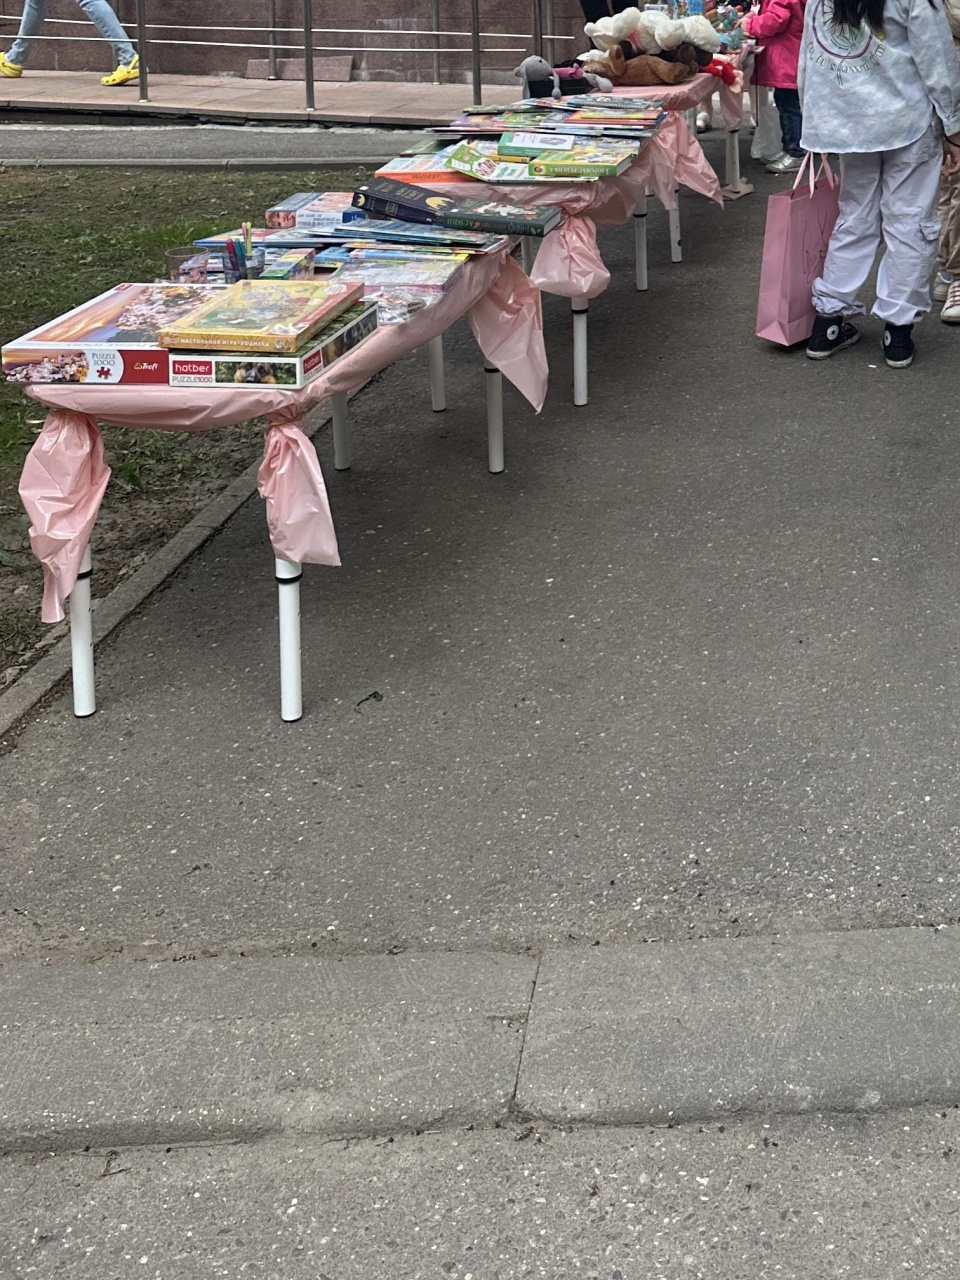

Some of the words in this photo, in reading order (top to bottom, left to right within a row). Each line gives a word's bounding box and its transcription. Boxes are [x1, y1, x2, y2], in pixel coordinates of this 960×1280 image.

[91, 352, 117, 361] PUZZLE
[93, 359, 116, 367] 1000
[141, 362, 159, 371] Trefl
[174, 362, 210, 374] hatber
